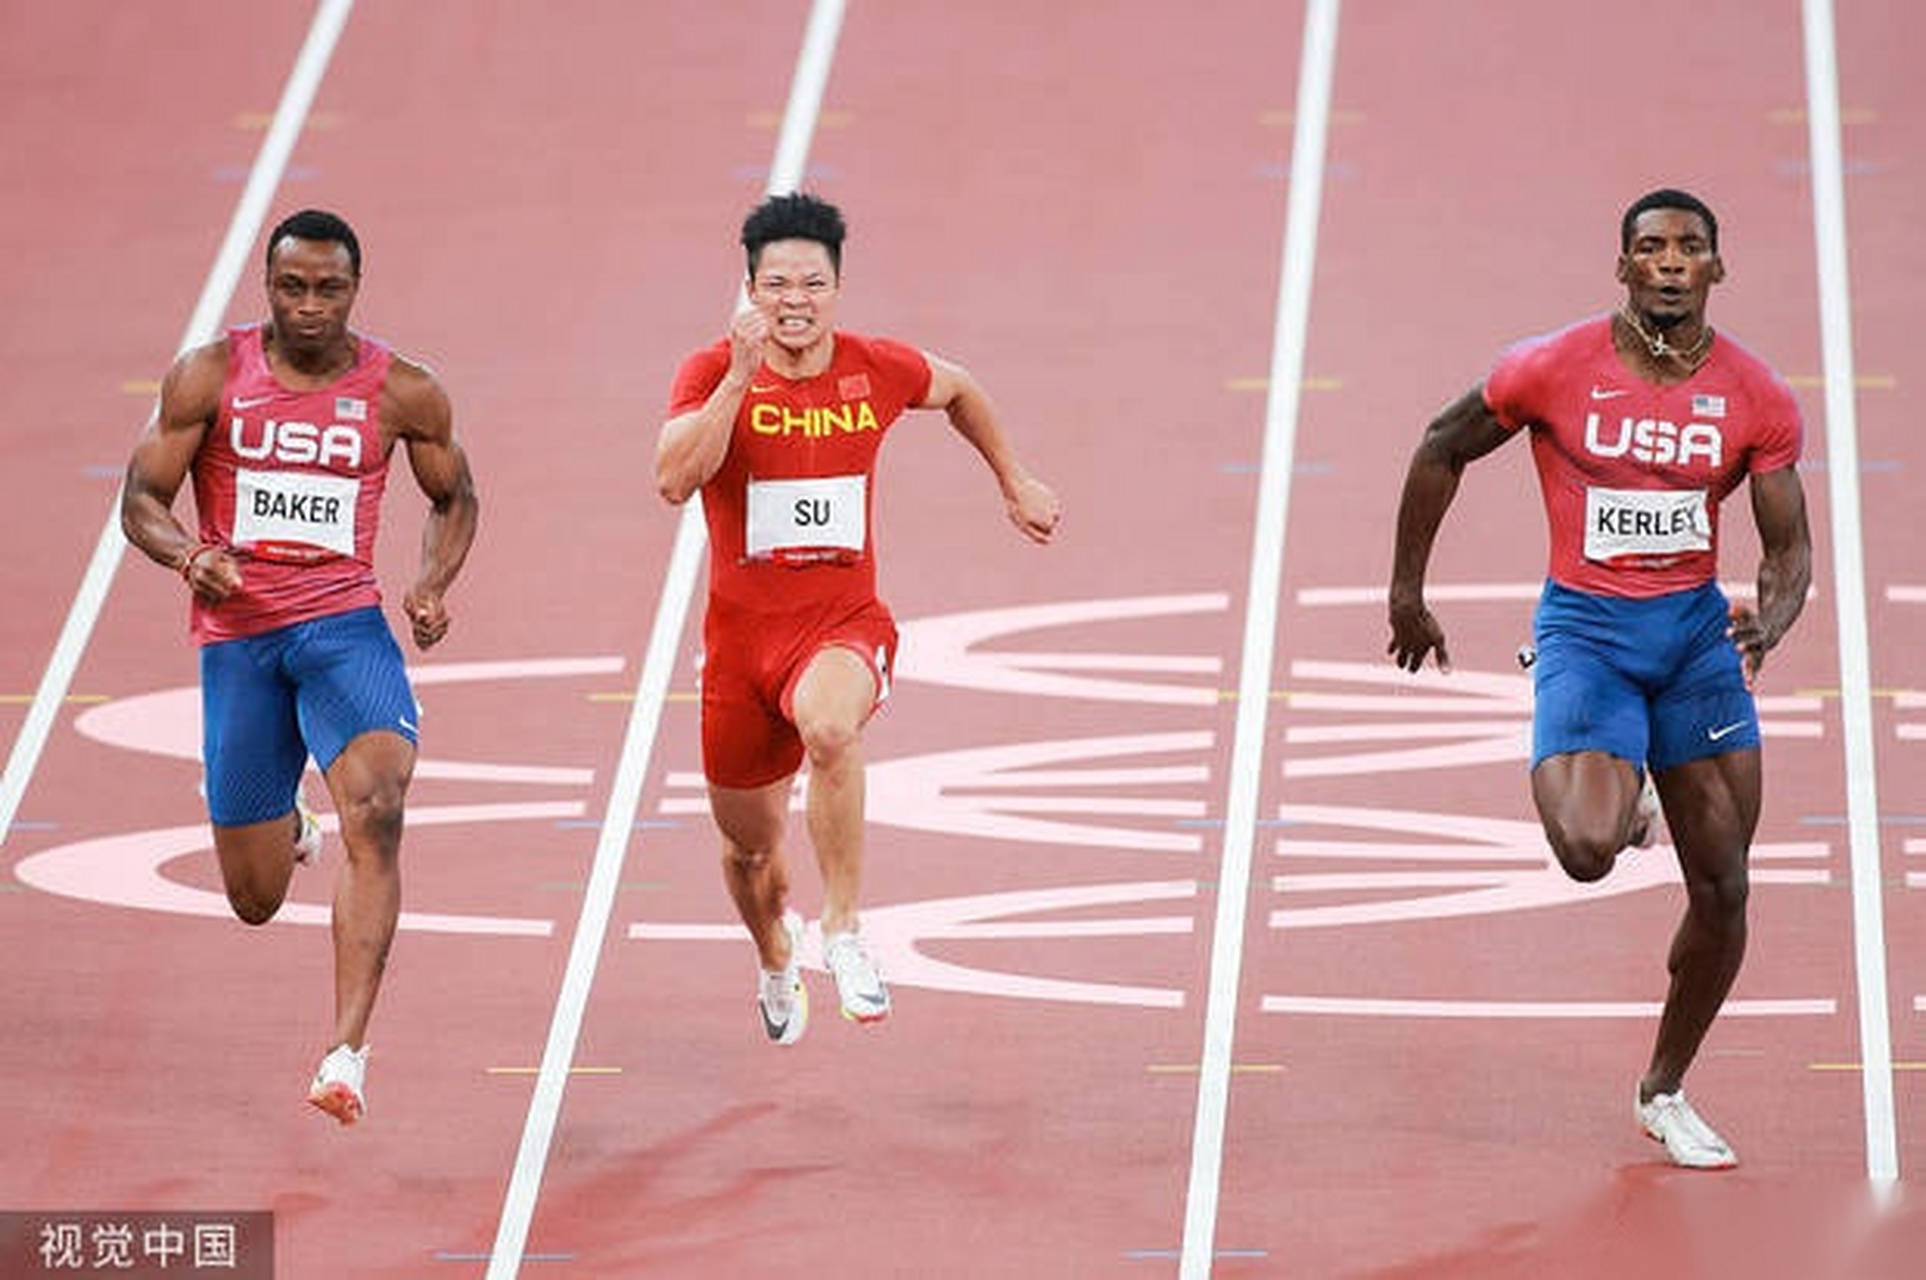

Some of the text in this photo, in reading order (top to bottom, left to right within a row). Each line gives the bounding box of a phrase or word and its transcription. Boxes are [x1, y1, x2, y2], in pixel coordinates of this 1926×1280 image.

[751, 402, 878, 437] CHINA
[230, 417, 362, 467] USA
[1585, 413, 1722, 467] USA
[253, 489, 340, 523] BAKER
[794, 499, 831, 526] SU
[1599, 503, 1697, 536] KERLEY
